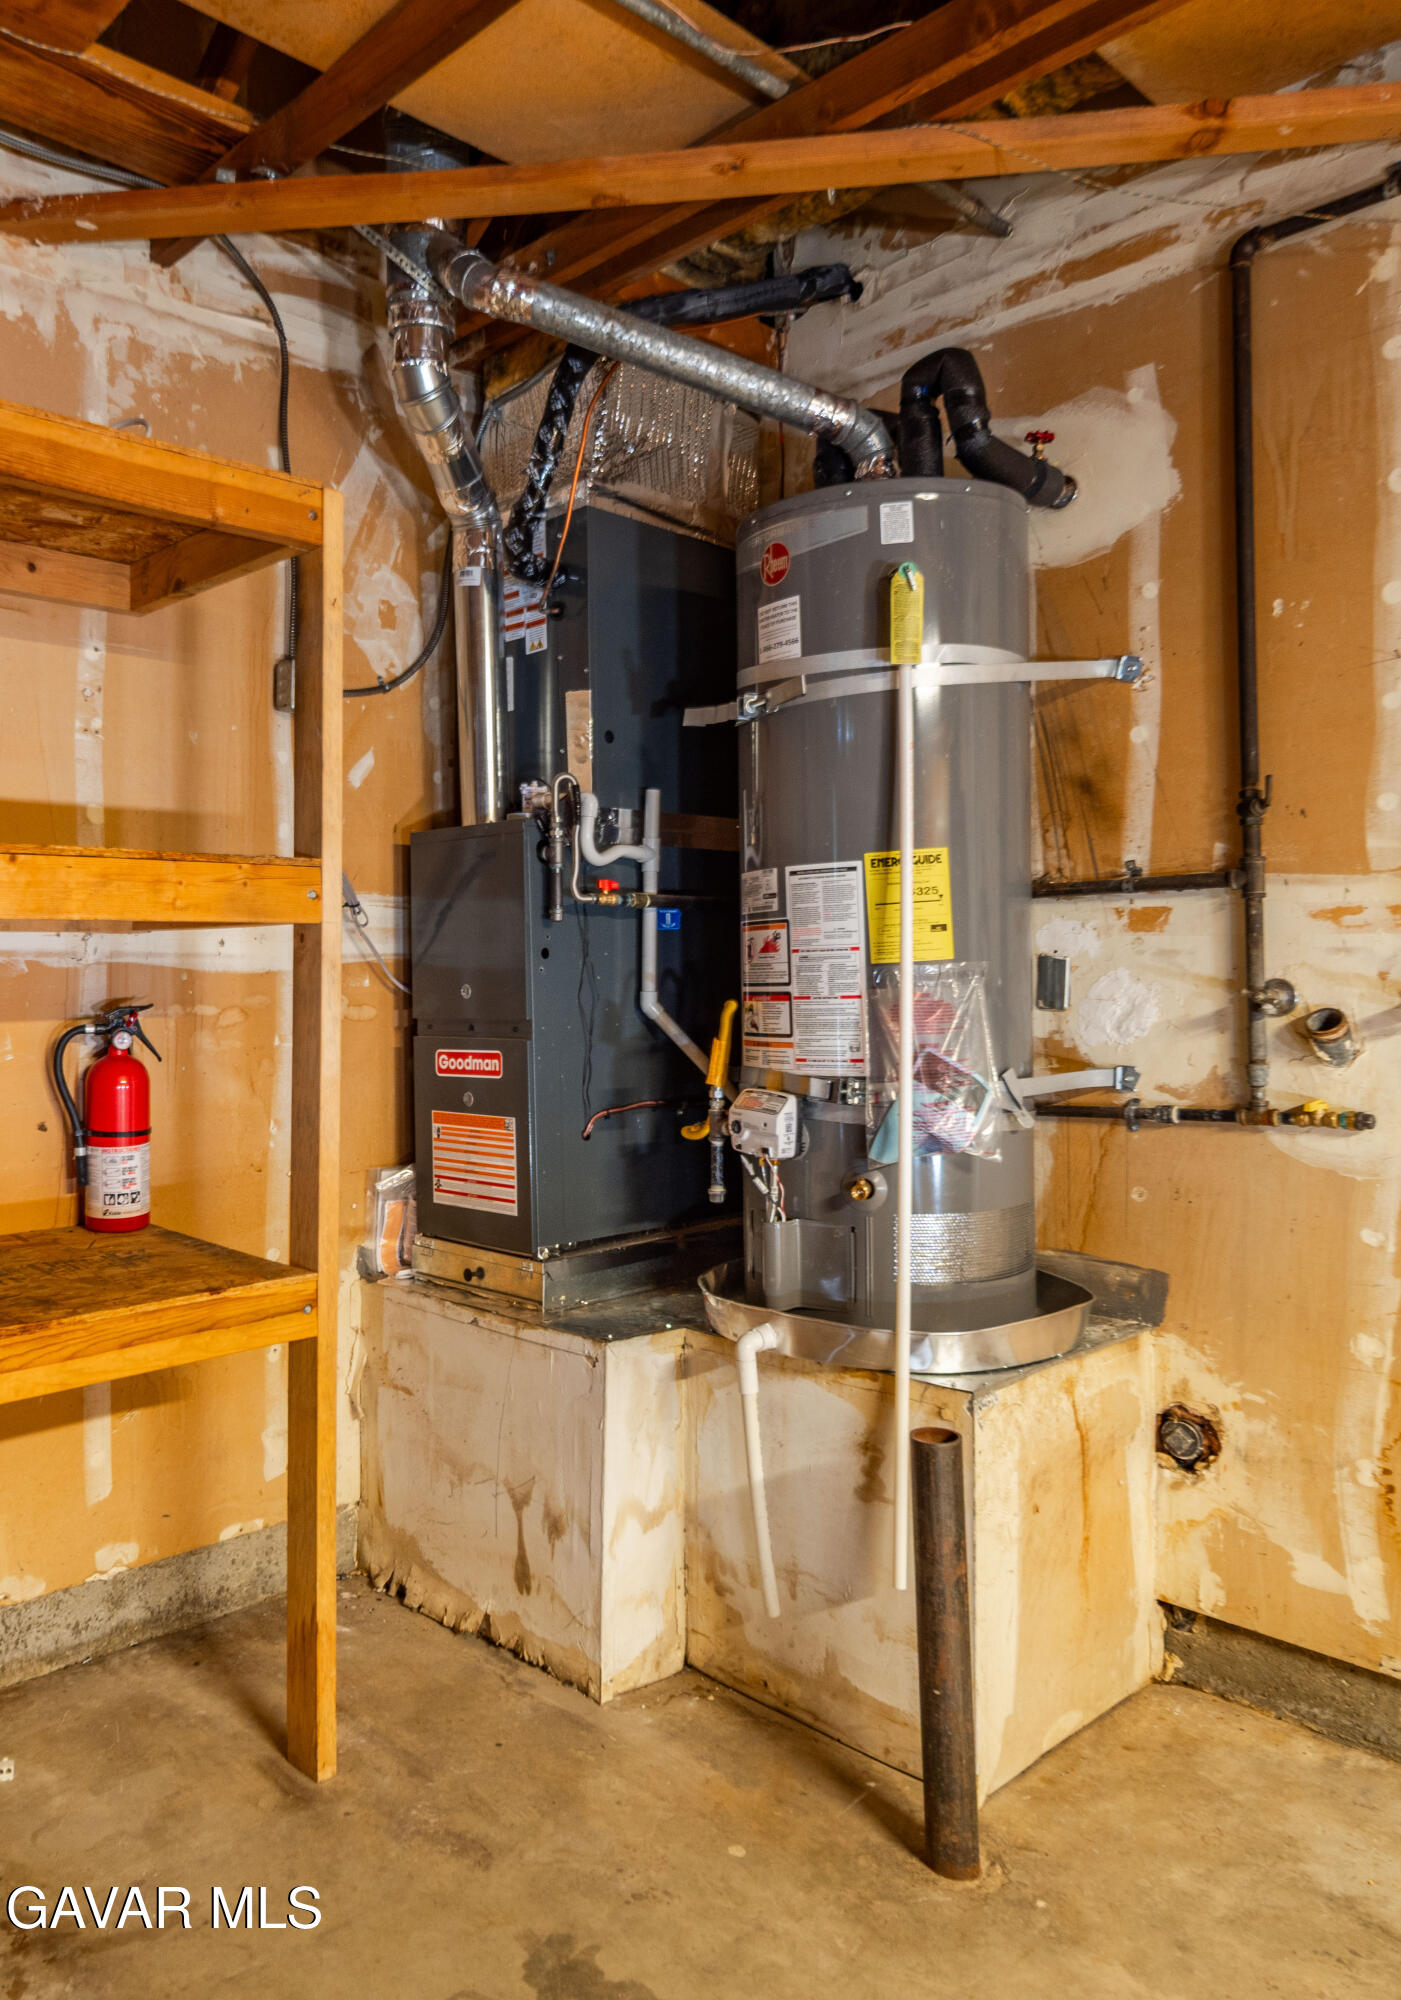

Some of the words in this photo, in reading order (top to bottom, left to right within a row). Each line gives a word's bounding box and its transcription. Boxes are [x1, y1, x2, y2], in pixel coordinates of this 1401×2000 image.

[763, 545, 788, 579] Rheem
[913, 886, 939, 896] 325
[439, 1054, 500, 1071] Goodman
